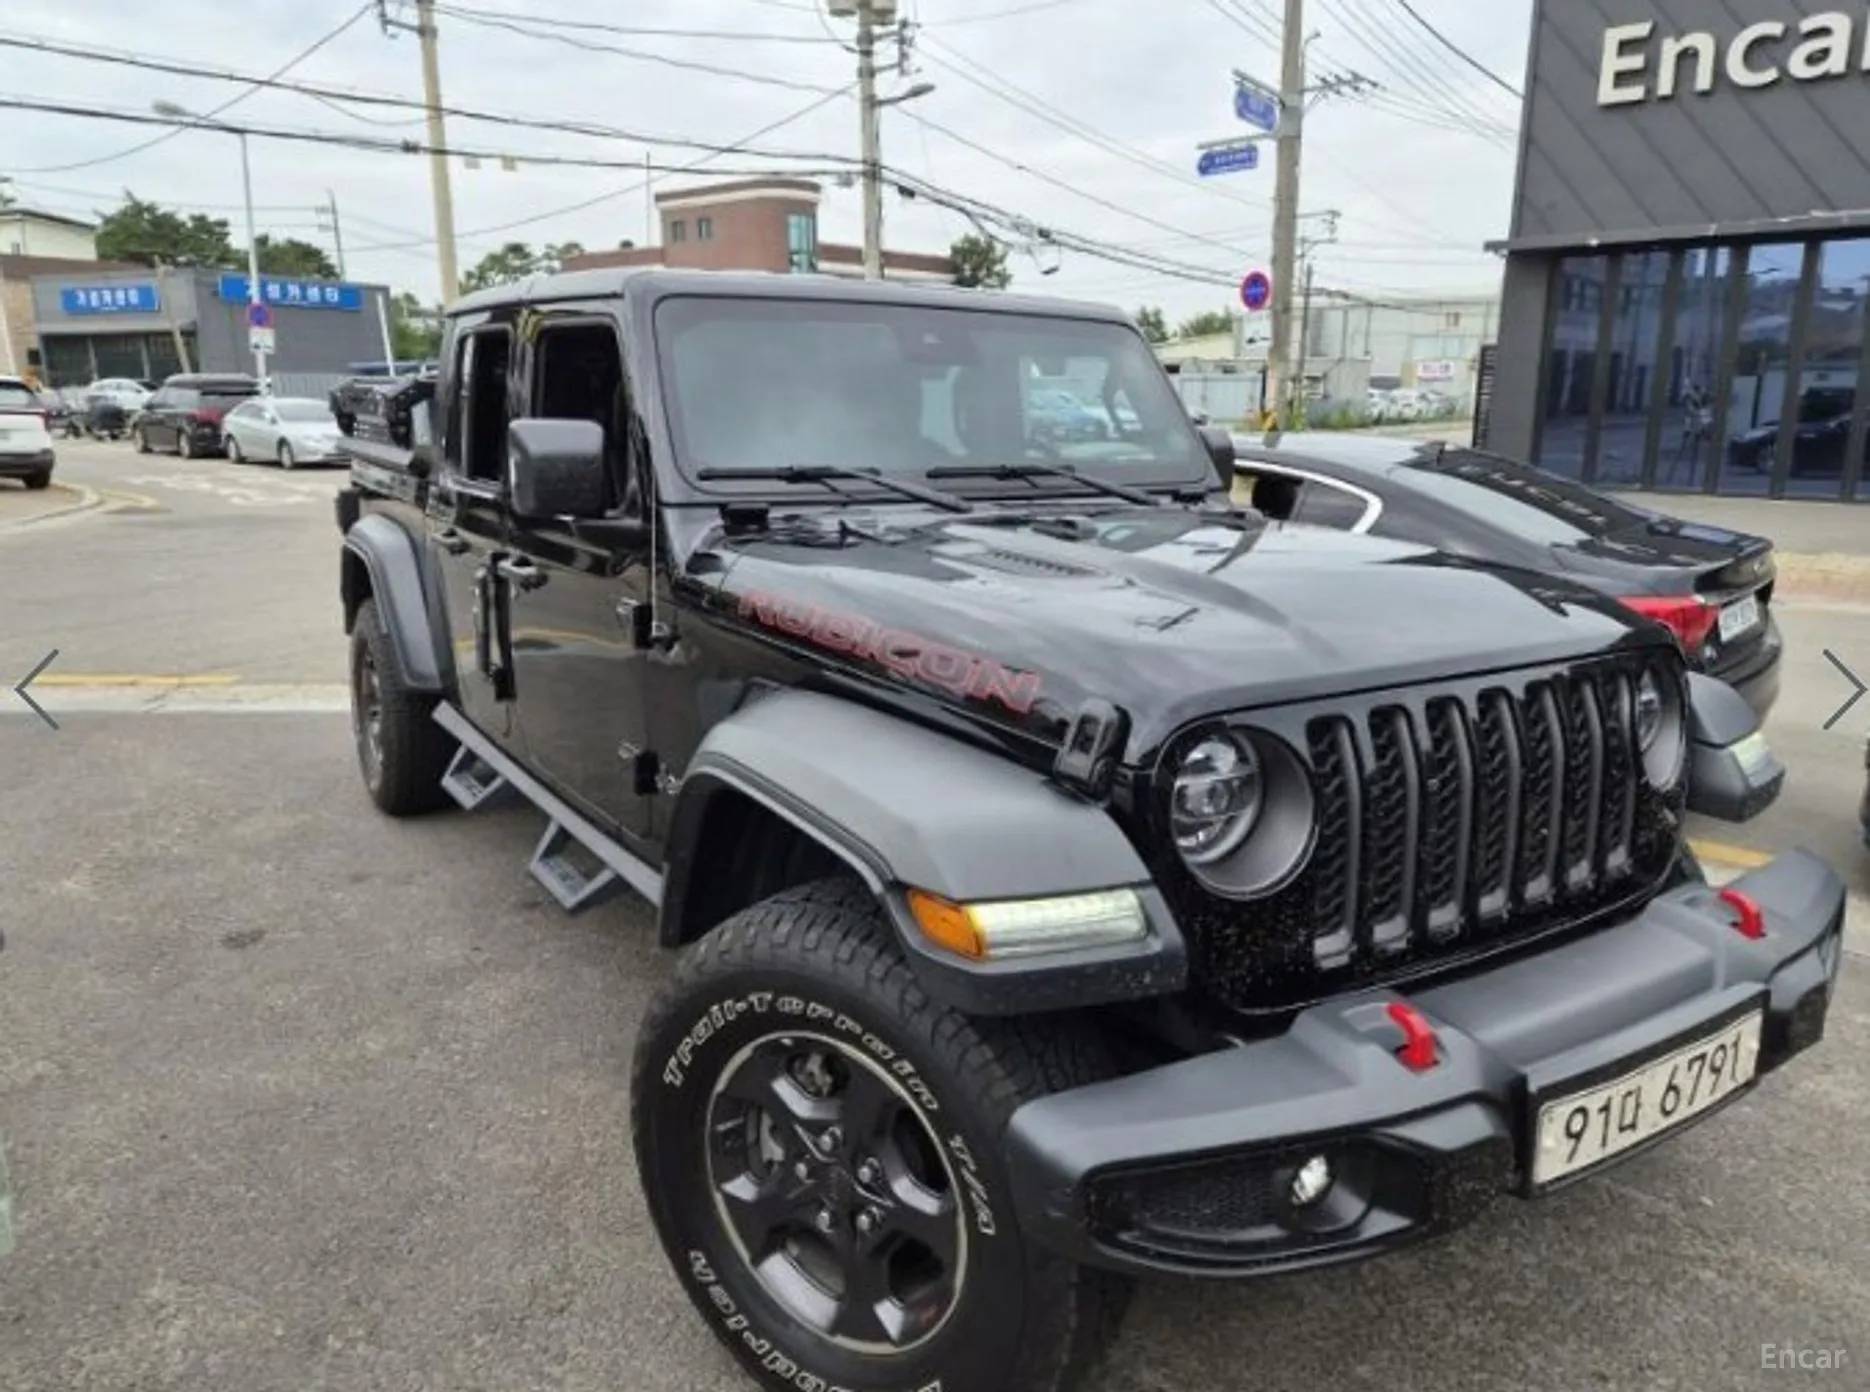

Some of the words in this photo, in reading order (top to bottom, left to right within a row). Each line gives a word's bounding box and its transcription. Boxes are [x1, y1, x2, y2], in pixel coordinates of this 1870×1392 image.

[1597, 11, 1870, 106] Enca
[738, 593, 1041, 714] RUBICON
[663, 991, 939, 1111] Trail-Terrain
[950, 1134, 996, 1236] T/A
[1564, 1085, 1643, 1164] 91마
[1659, 1031, 1742, 1118] 6791
